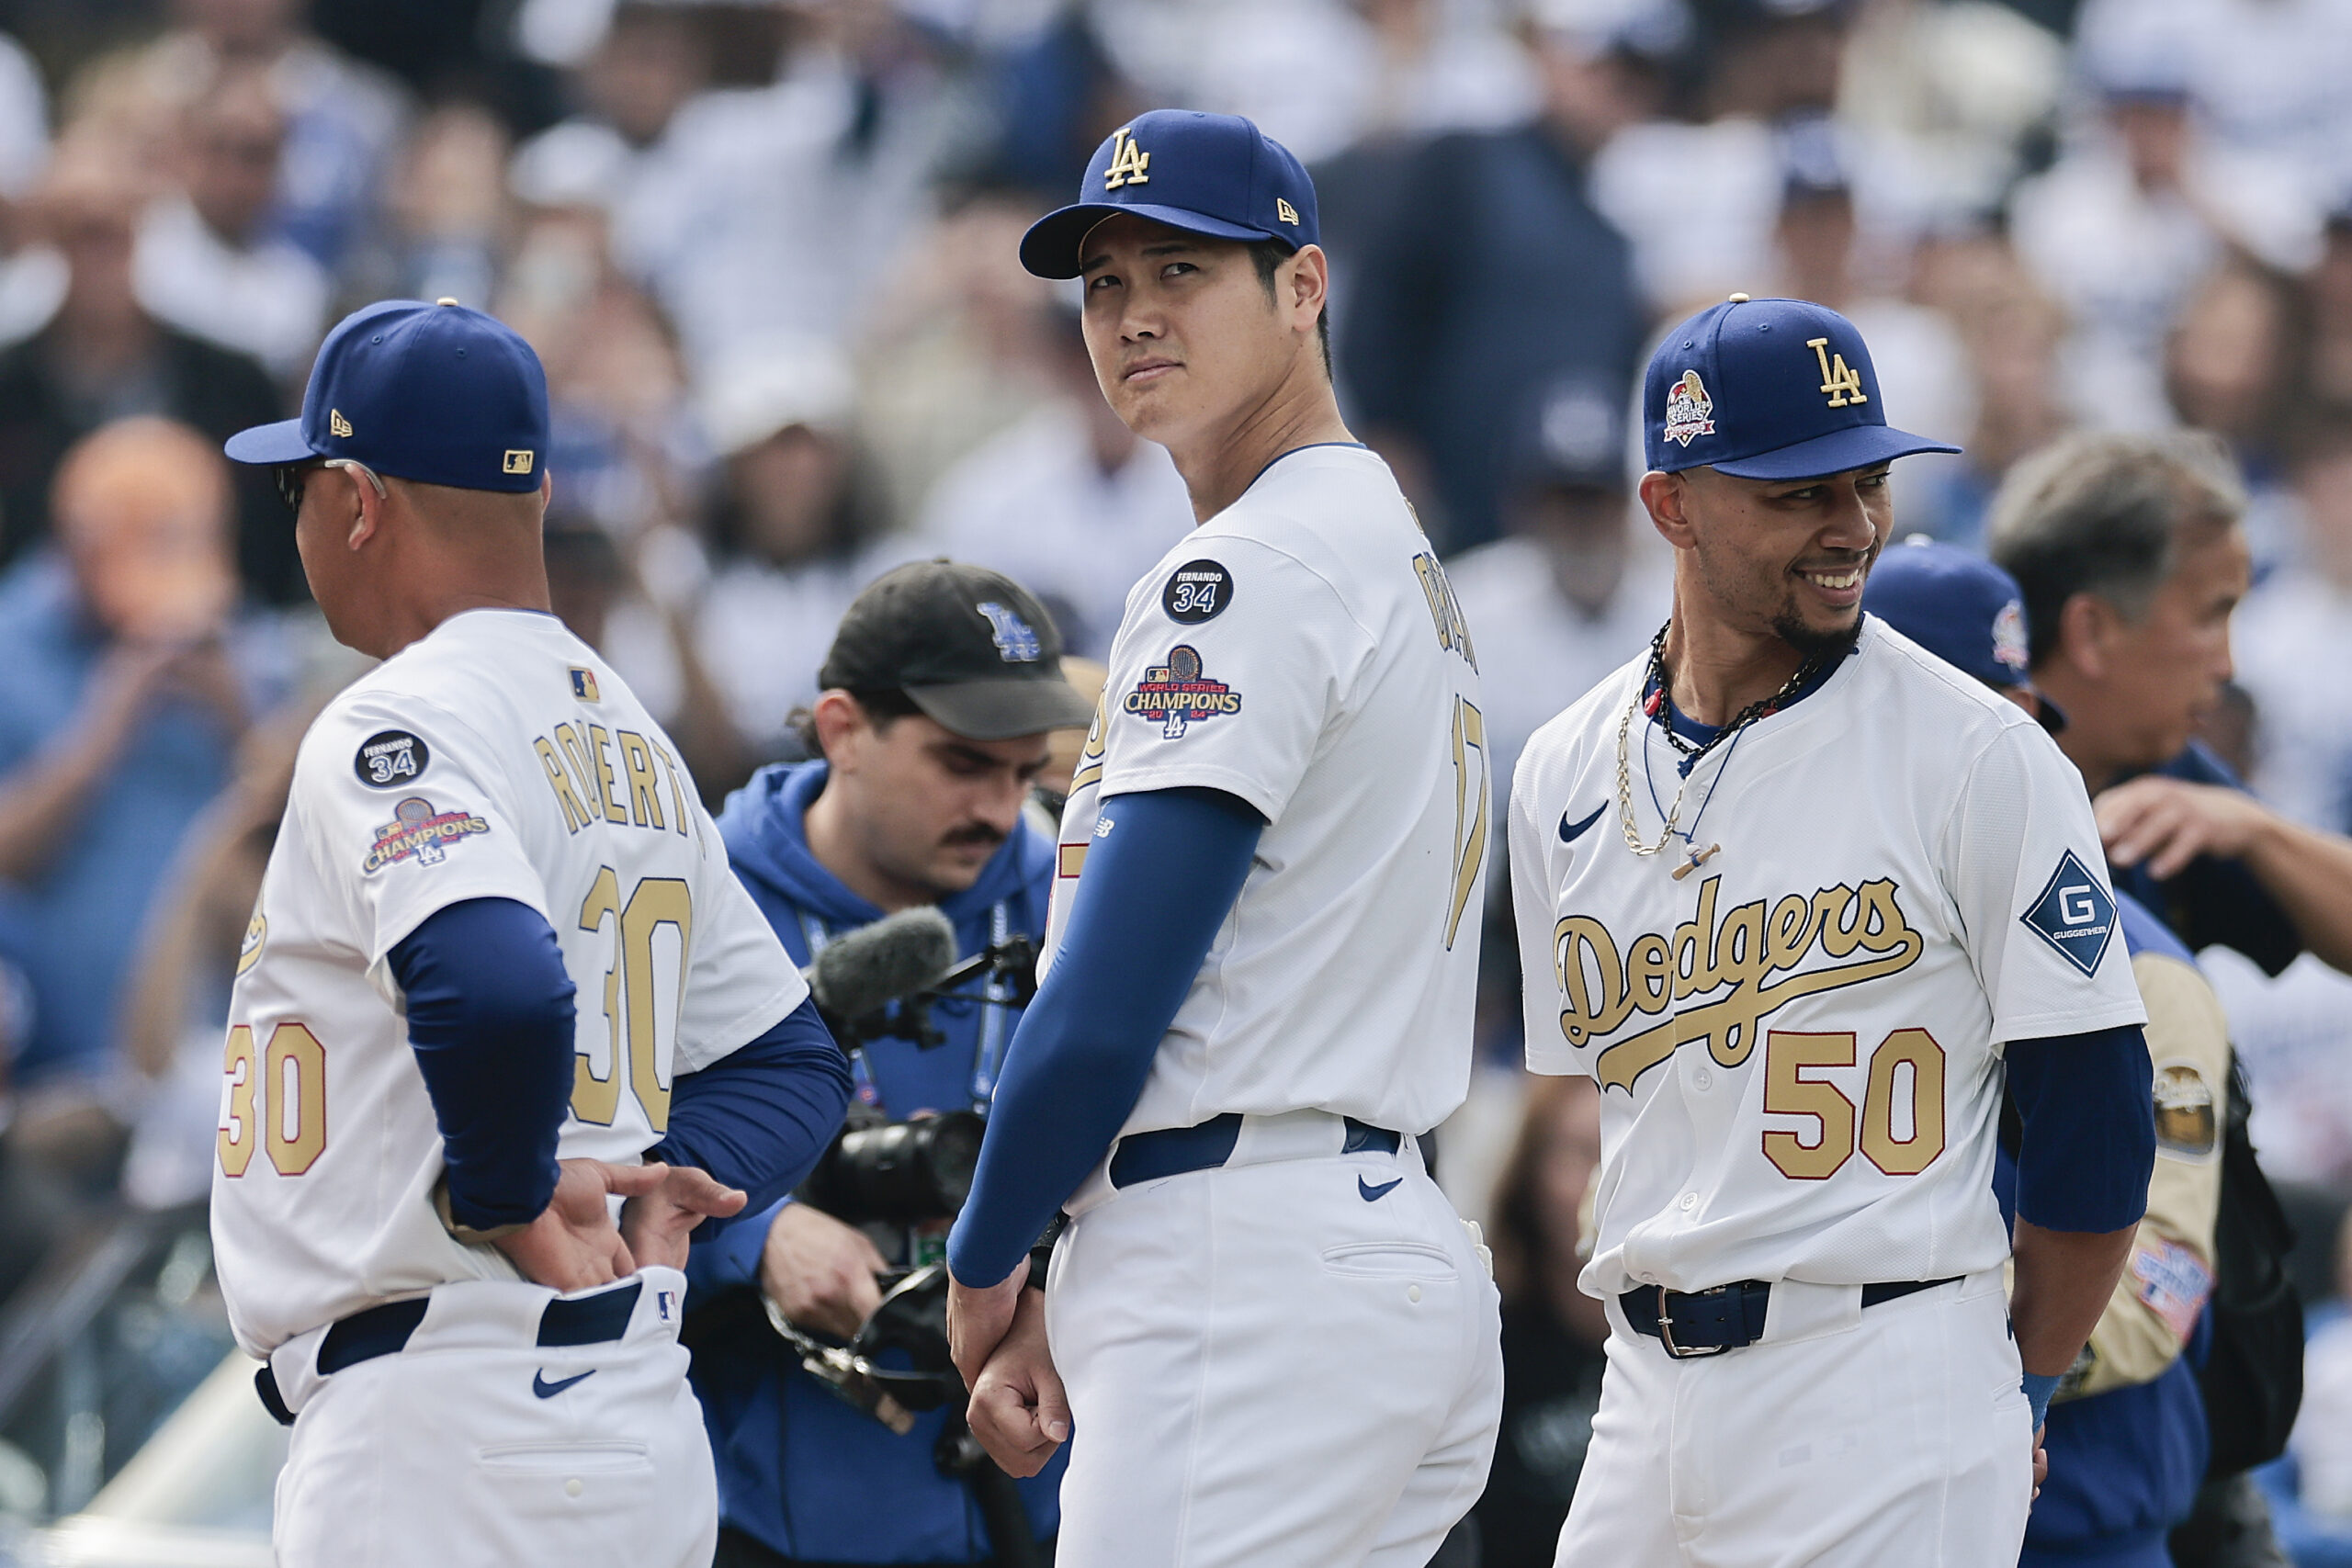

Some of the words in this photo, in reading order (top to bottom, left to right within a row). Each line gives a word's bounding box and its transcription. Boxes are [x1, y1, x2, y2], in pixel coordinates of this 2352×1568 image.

[1104, 128, 1149, 191] LA
[1806, 337, 1868, 408] LA
[1668, 401, 1701, 416] WORLD
[1671, 410, 1704, 426] SERIES
[1177, 572, 1223, 583] FERNANDO
[1172, 583, 1217, 614] 34
[1125, 693, 1240, 713] CHAMPIONS
[1138, 682, 1179, 692] WORLD
[1182, 682, 1227, 694] SERIES
[1164, 710, 1185, 738] LA
[364, 738, 413, 759] FERNANDO
[368, 749, 417, 783] 34
[364, 818, 490, 871] CHAMPIONS
[2053, 926, 2107, 940] GUGGENHEIM
[1553, 874, 1911, 1069] Dodgers
[570, 864, 692, 1134] 30
[218, 1021, 326, 1178] 30
[1761, 1027, 1946, 1179] 50
